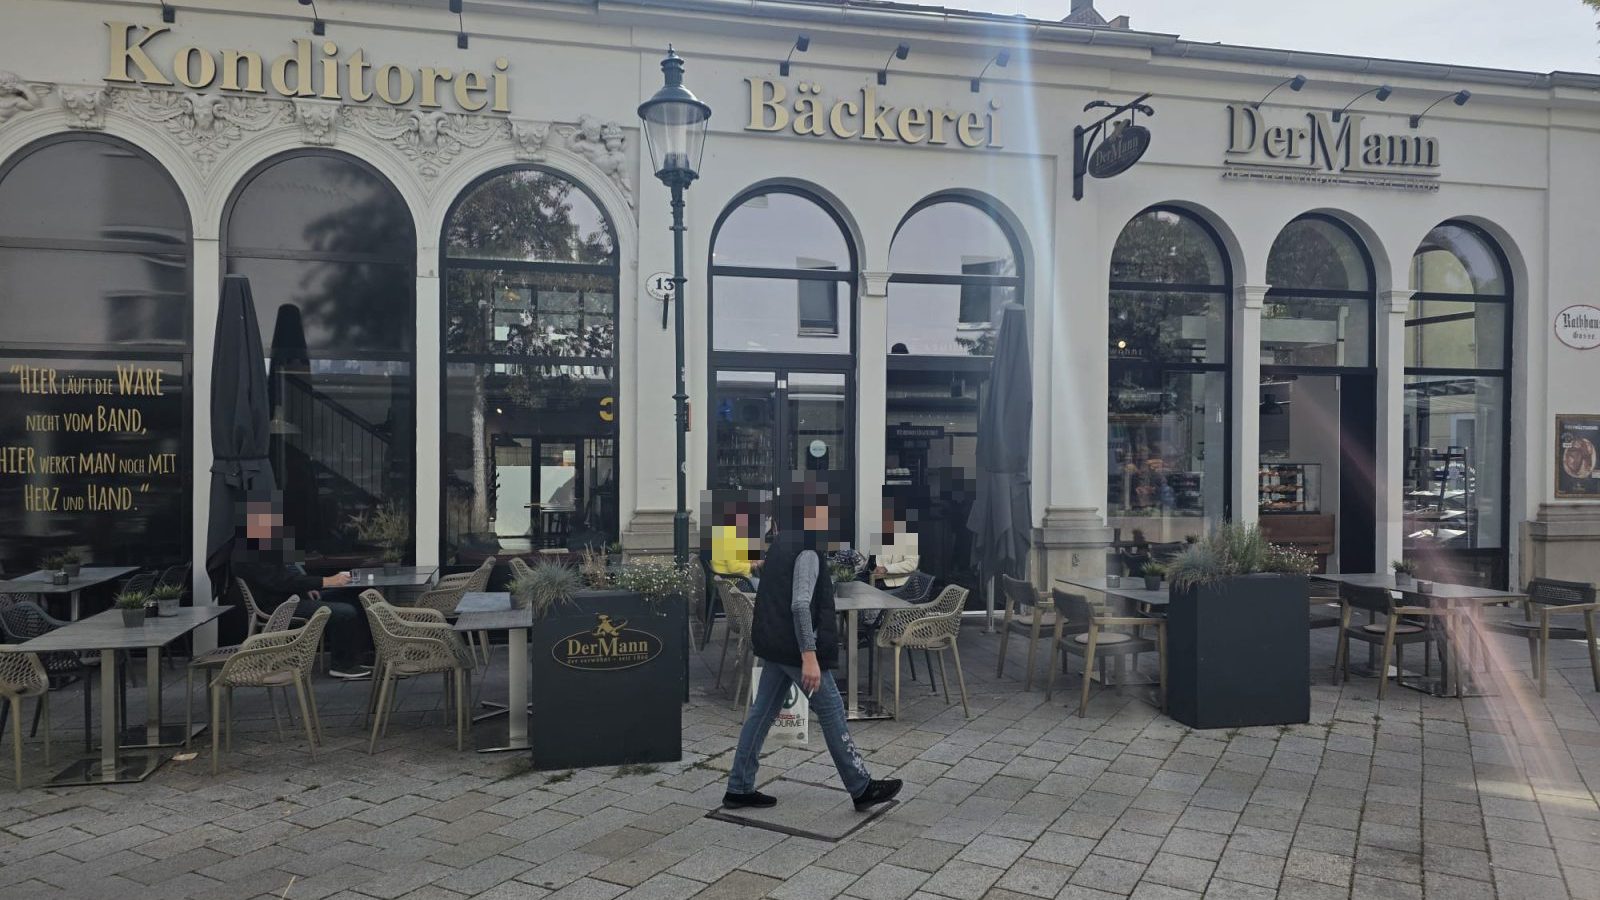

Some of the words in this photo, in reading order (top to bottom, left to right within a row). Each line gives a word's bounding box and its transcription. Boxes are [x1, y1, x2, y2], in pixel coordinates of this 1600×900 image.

[103, 21, 511, 112] Konditorei
[744, 77, 1004, 149] Bäckerei
[656, 277, 675, 291] 13
[95, 378, 113, 395] DIE
[117, 363, 165, 397] WARE
[26, 415, 60, 432] NICHT
[63, 413, 93, 433] VOM
[97, 405, 147, 435] BAND,
[39, 455, 76, 474] WERKT
[79, 452, 116, 475] MAN
[119, 458, 145, 474] NOCH
[148, 453, 177, 475] MIT
[24, 484, 60, 512] HERZ
[63, 497, 84, 511] UND
[567, 637, 648, 656] DerMann
